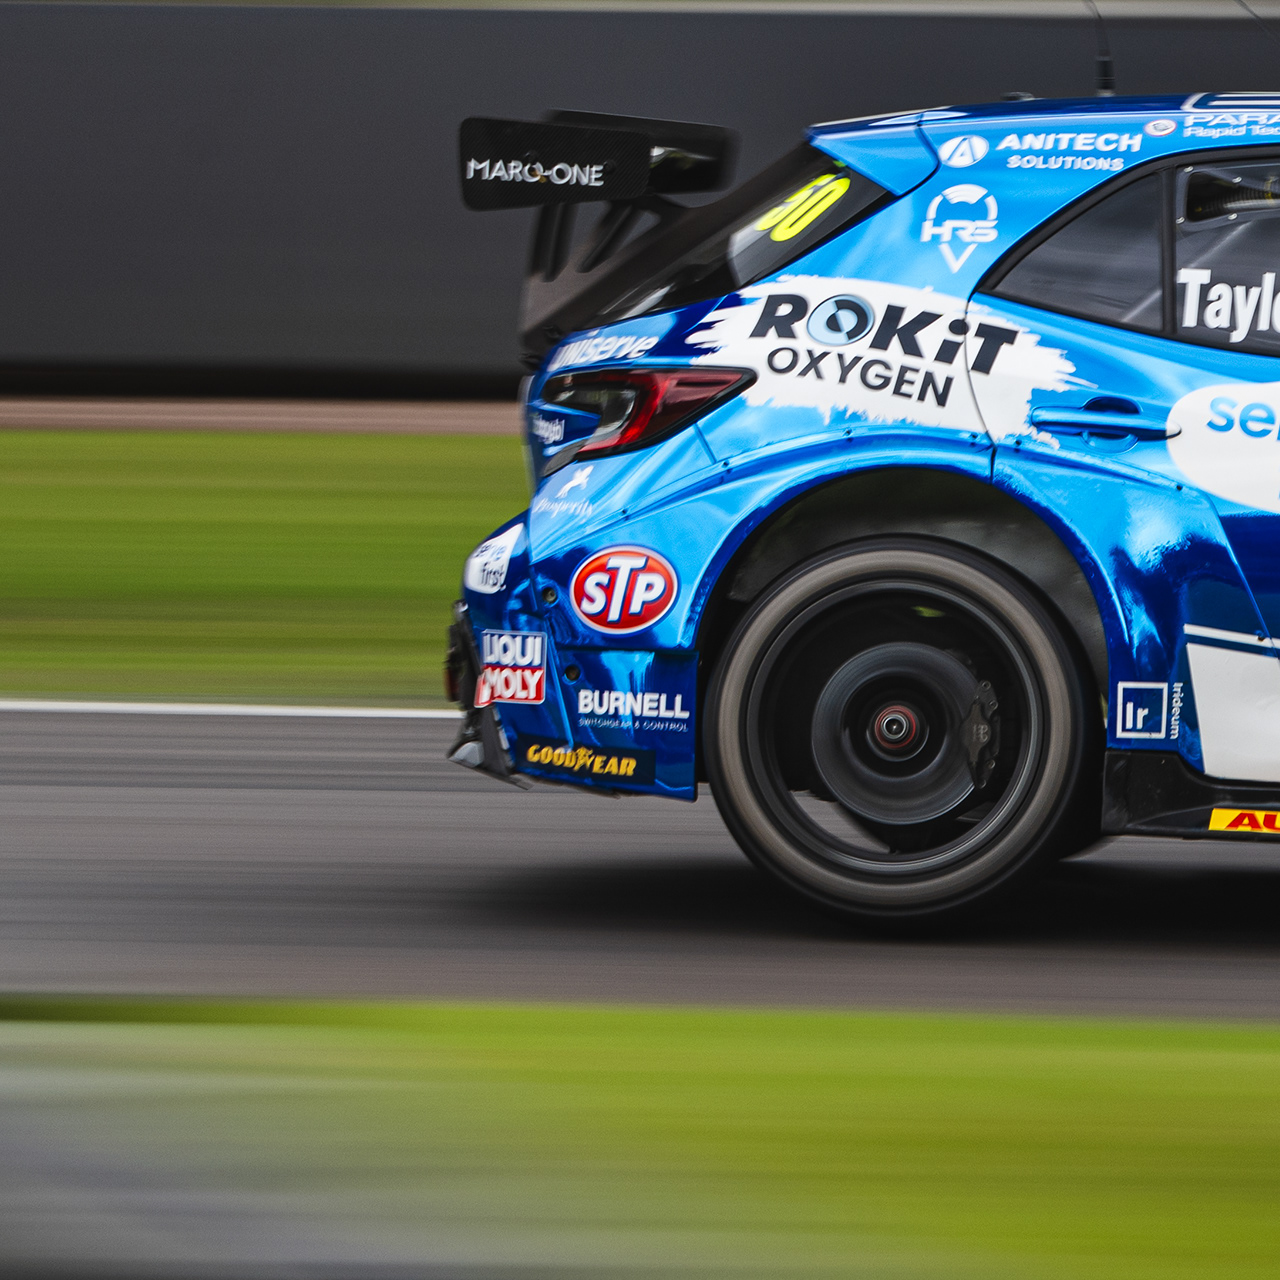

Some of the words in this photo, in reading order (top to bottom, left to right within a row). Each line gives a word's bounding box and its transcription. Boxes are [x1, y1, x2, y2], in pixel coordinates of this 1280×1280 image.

[995, 133, 1143, 152] ANITECH
[1183, 124, 1247, 138] Rapid
[1006, 155, 1124, 171] SOLUTIONS
[921, 219, 999, 243] HRS
[767, 346, 954, 408] OXYGEN
[579, 556, 667, 621] STP
[482, 634, 542, 667] LIQUI
[478, 668, 544, 704] MOLY
[578, 689, 690, 719] BURNELL
[643, 721, 688, 732] CONTROL
[527, 744, 638, 777] GOODYEAR
